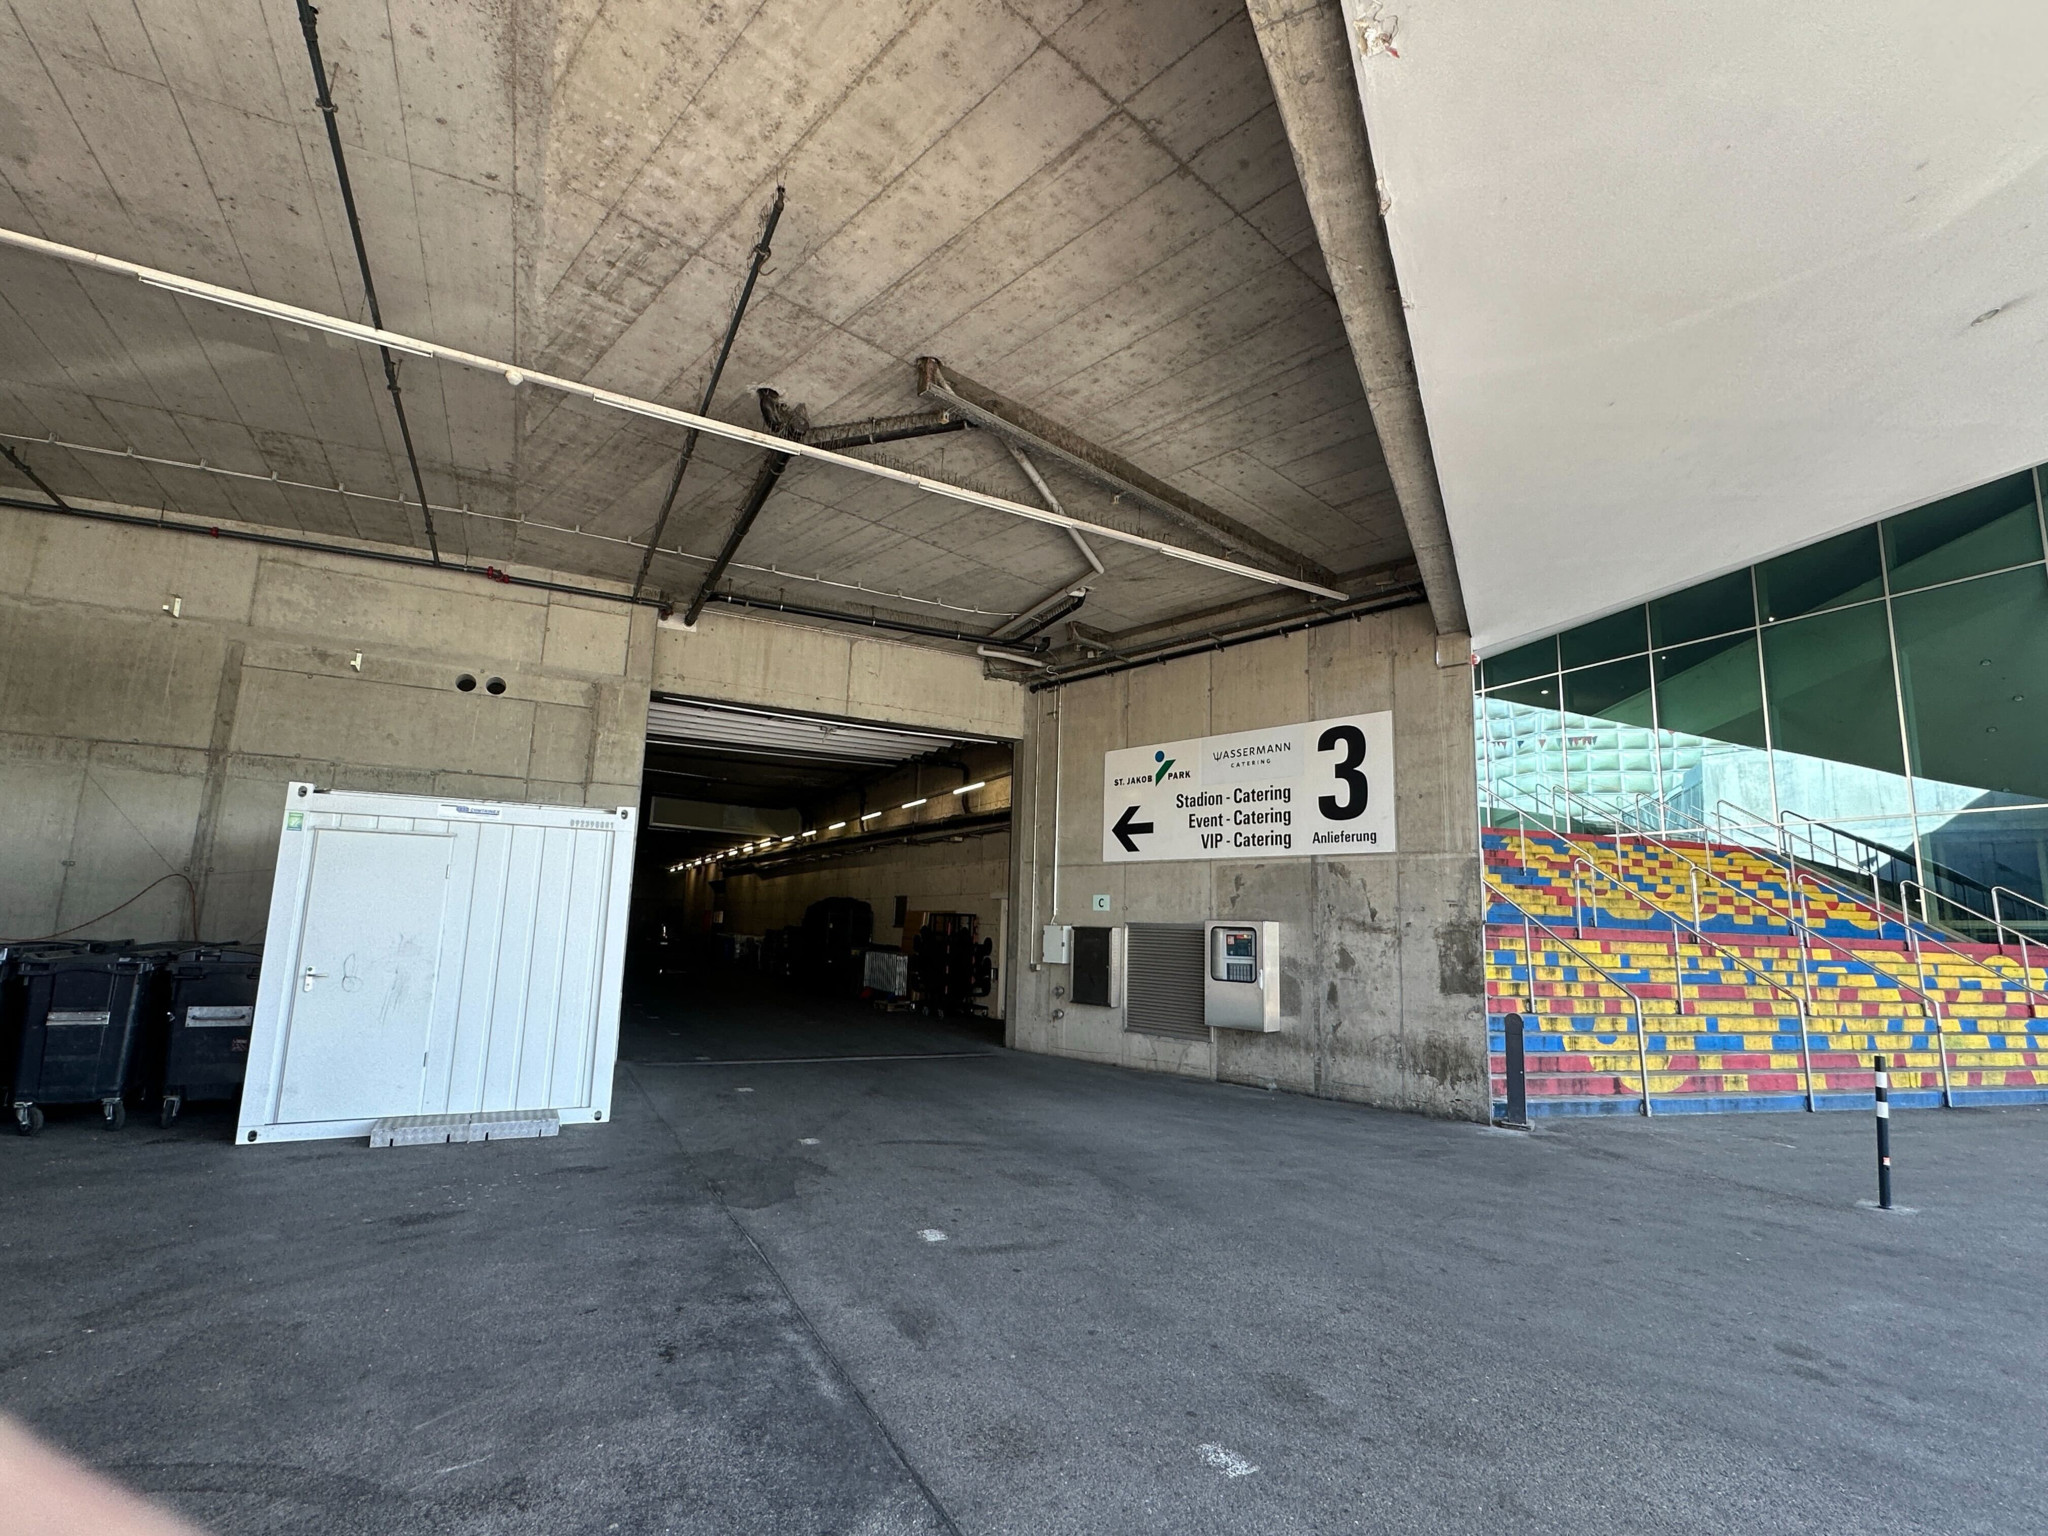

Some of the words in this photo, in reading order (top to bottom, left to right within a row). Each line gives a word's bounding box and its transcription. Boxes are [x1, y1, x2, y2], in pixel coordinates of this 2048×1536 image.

[1212, 741, 1292, 762] WASSERMANN
[1230, 758, 1272, 768] CATERING
[1317, 724, 1369, 821] 3
[1114, 778, 1125, 787] ST.
[1126, 774, 1153, 786] JAKOB
[1167, 770, 1192, 780] PARK
[1175, 791, 1223, 809] Stadion
[1233, 784, 1291, 804] Catering
[1188, 813, 1224, 829] Event
[1233, 807, 1292, 827] Catering
[1200, 832, 1224, 849] VIP
[1233, 829, 1292, 850] Catering
[1312, 830, 1377, 844] Anlieferung
[1098, 897, 1105, 908] C
